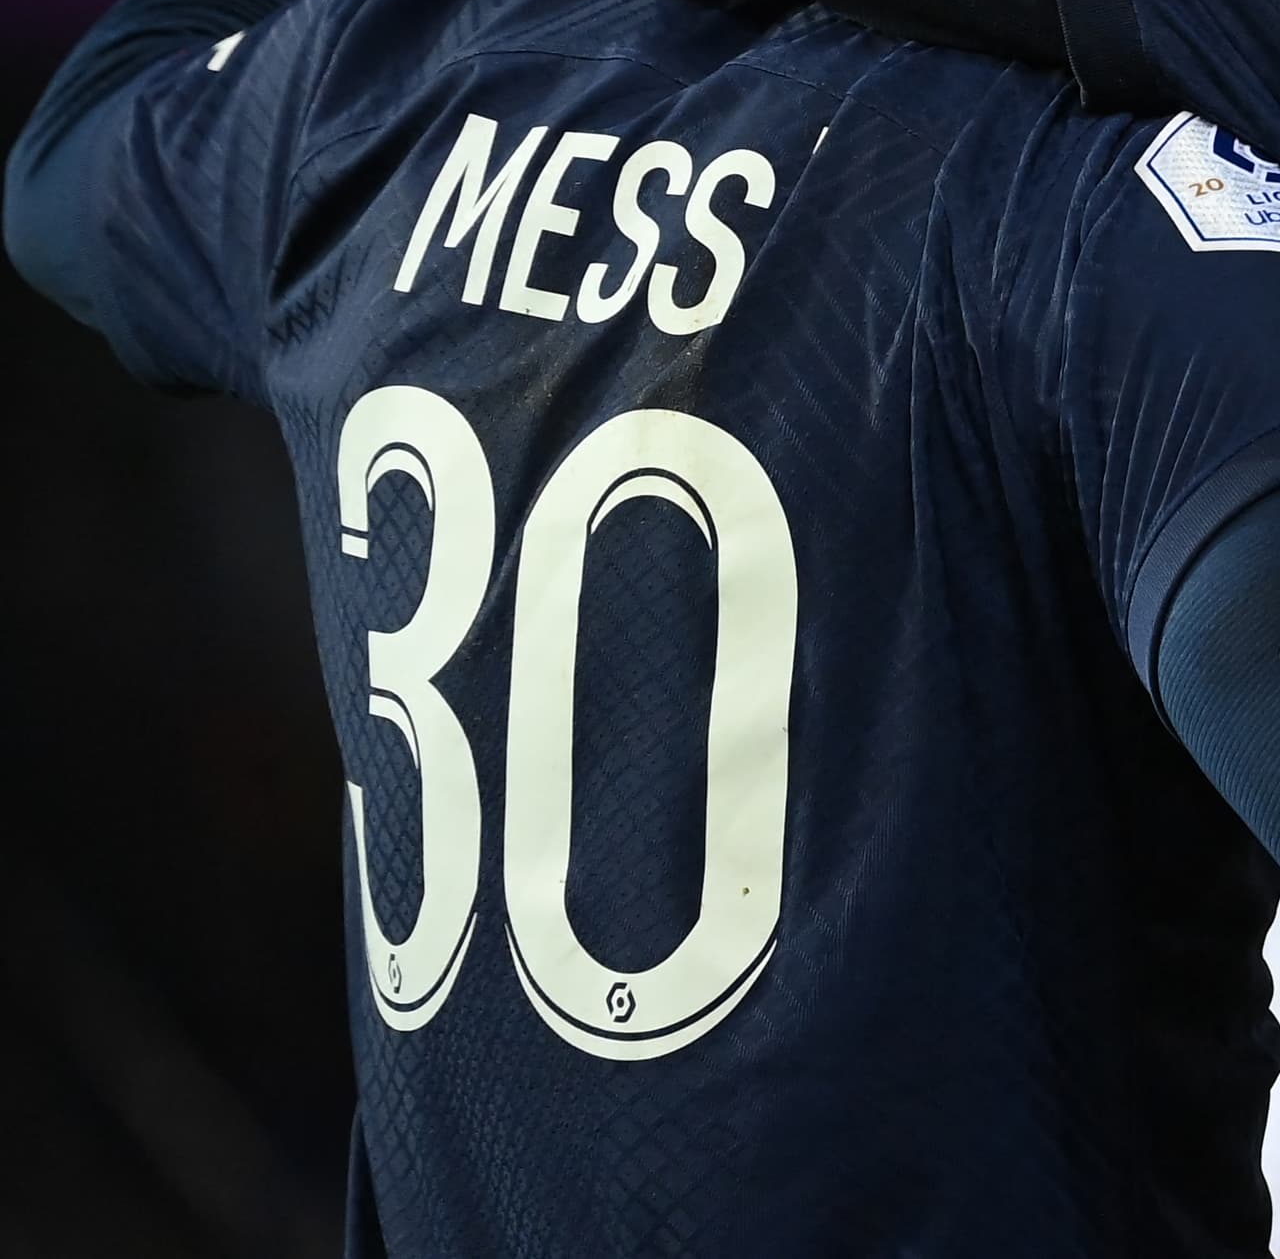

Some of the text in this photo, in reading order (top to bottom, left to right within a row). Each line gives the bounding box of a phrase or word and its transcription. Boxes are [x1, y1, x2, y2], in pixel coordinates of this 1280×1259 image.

[393, 113, 829, 336] MESS
[1188, 177, 1224, 197] 20
[337, 385, 799, 1061] 30
